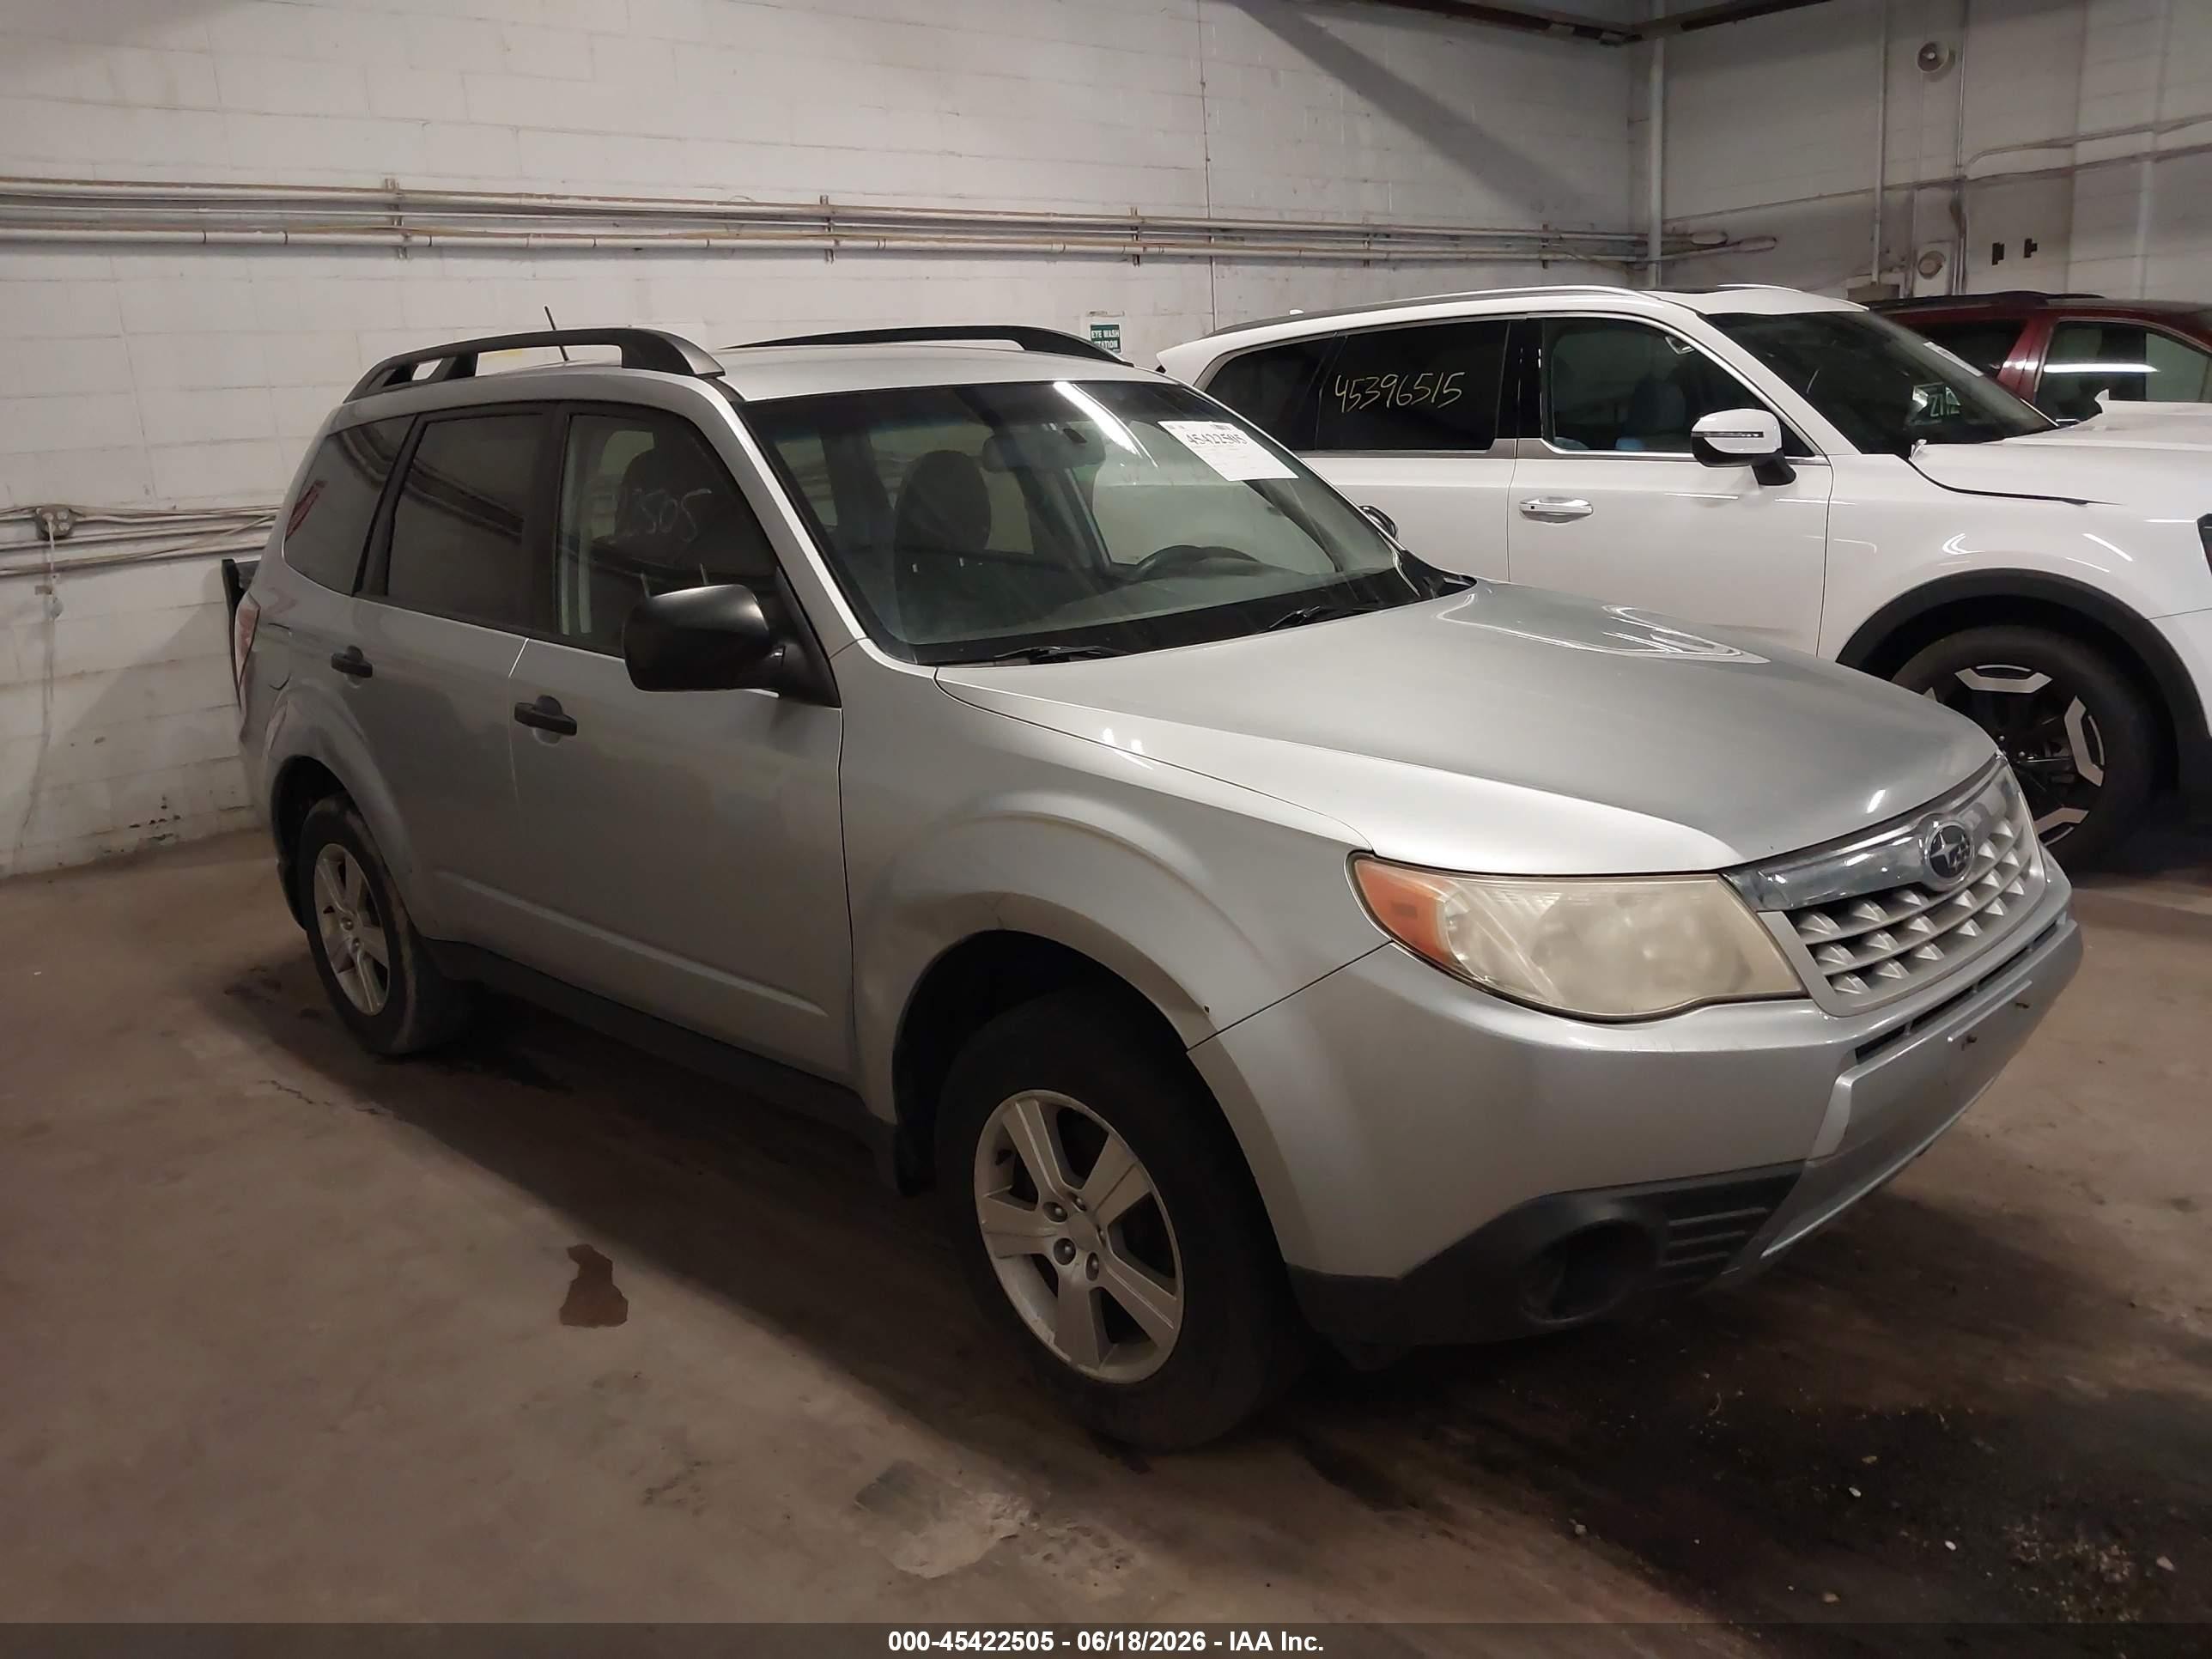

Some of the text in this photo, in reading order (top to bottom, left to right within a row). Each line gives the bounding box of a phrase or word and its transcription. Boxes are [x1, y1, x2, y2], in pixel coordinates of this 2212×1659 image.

[1091, 330, 1103, 338] EYE
[1334, 372, 1466, 412] 45396515
[1186, 433, 1248, 444] 45422505
